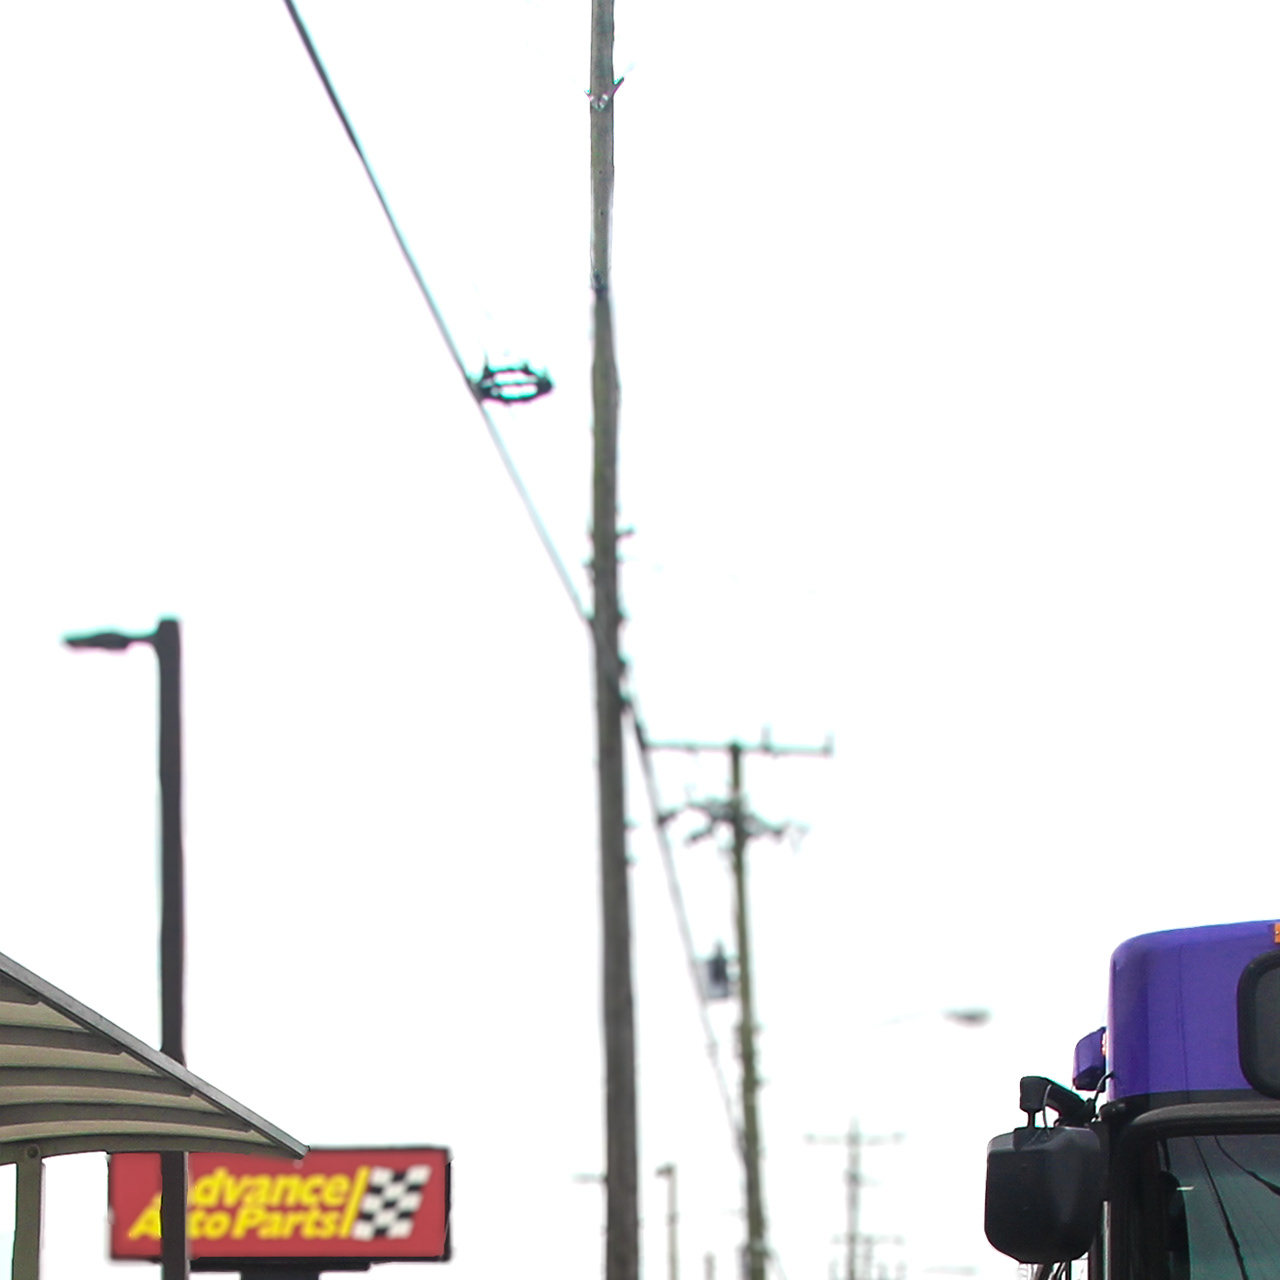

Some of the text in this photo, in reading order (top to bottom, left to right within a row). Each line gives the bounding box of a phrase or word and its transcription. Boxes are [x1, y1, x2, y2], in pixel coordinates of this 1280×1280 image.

[182, 1167, 353, 1209] dvance
[128, 1193, 341, 1240] Ato Parts
